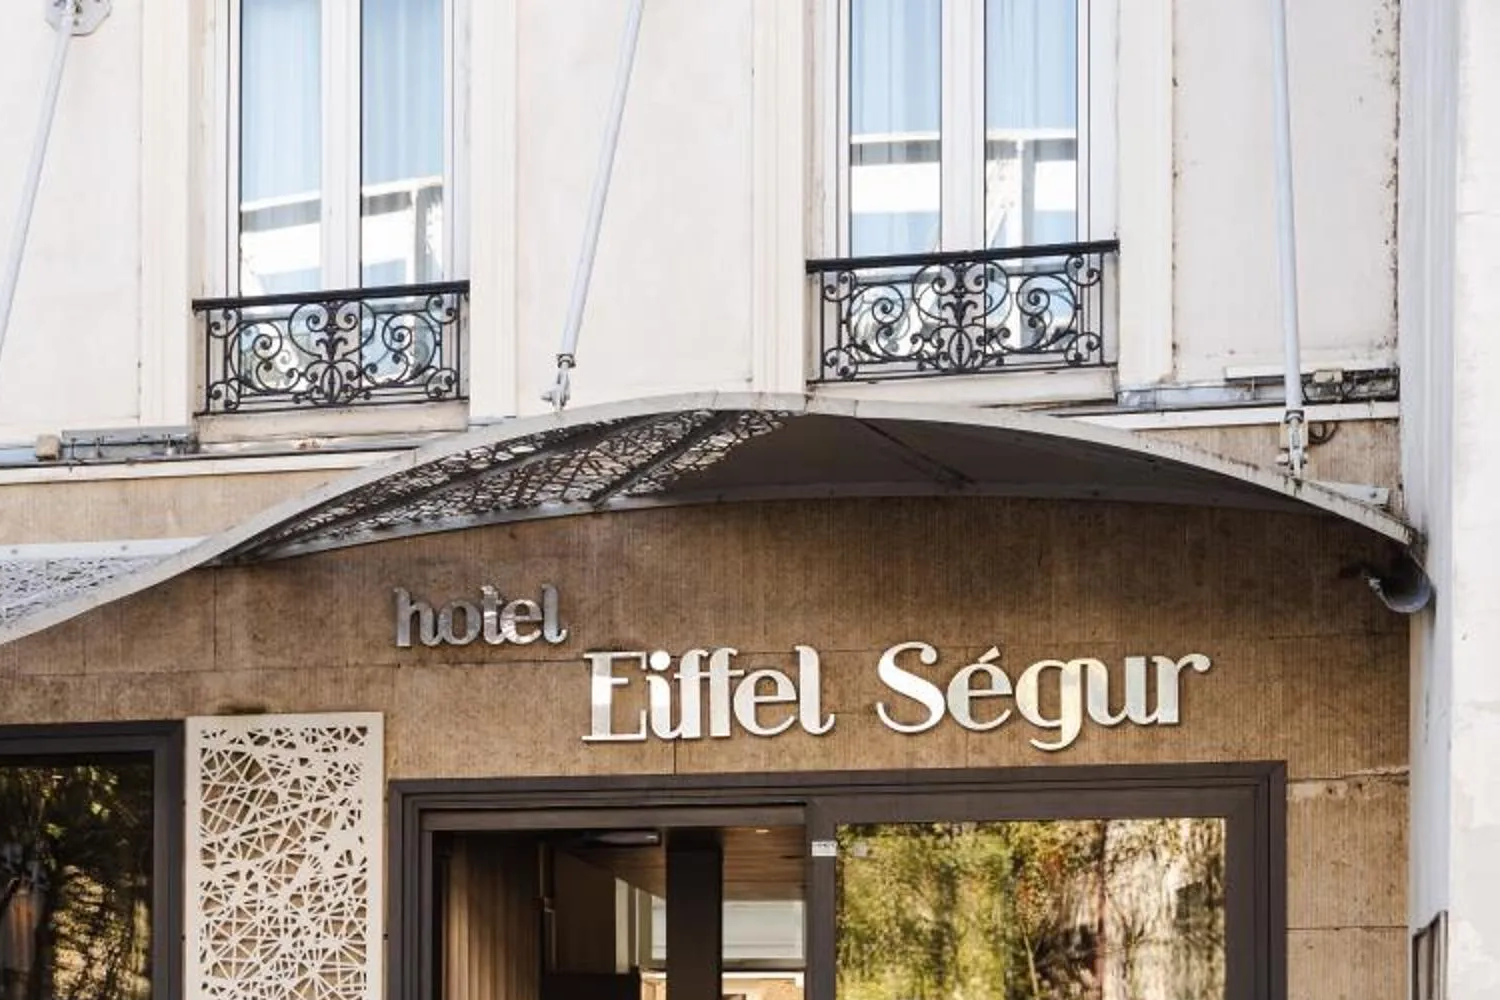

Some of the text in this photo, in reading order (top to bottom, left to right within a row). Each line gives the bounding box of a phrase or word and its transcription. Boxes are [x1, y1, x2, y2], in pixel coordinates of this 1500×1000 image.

[394, 584, 567, 647] hotel
[581, 641, 1212, 751] Eiffel Ségur
